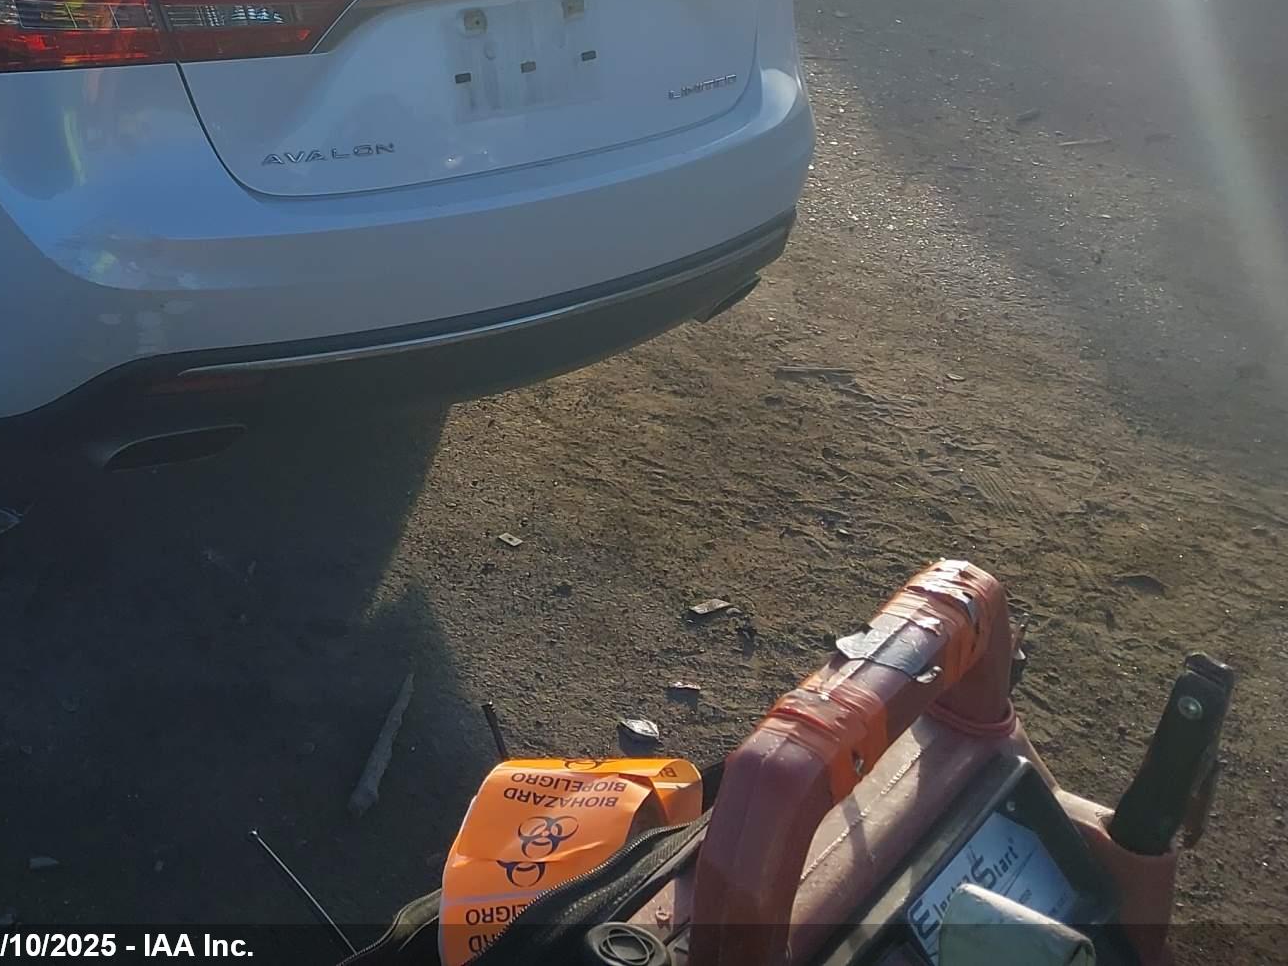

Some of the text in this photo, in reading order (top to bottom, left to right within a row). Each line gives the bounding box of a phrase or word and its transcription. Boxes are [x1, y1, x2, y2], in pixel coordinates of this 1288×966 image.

[262, 143, 395, 166] AVALON
[511, 772, 627, 793] BIOPELIGRO
[503, 787, 619, 808] BIOHAZARD
